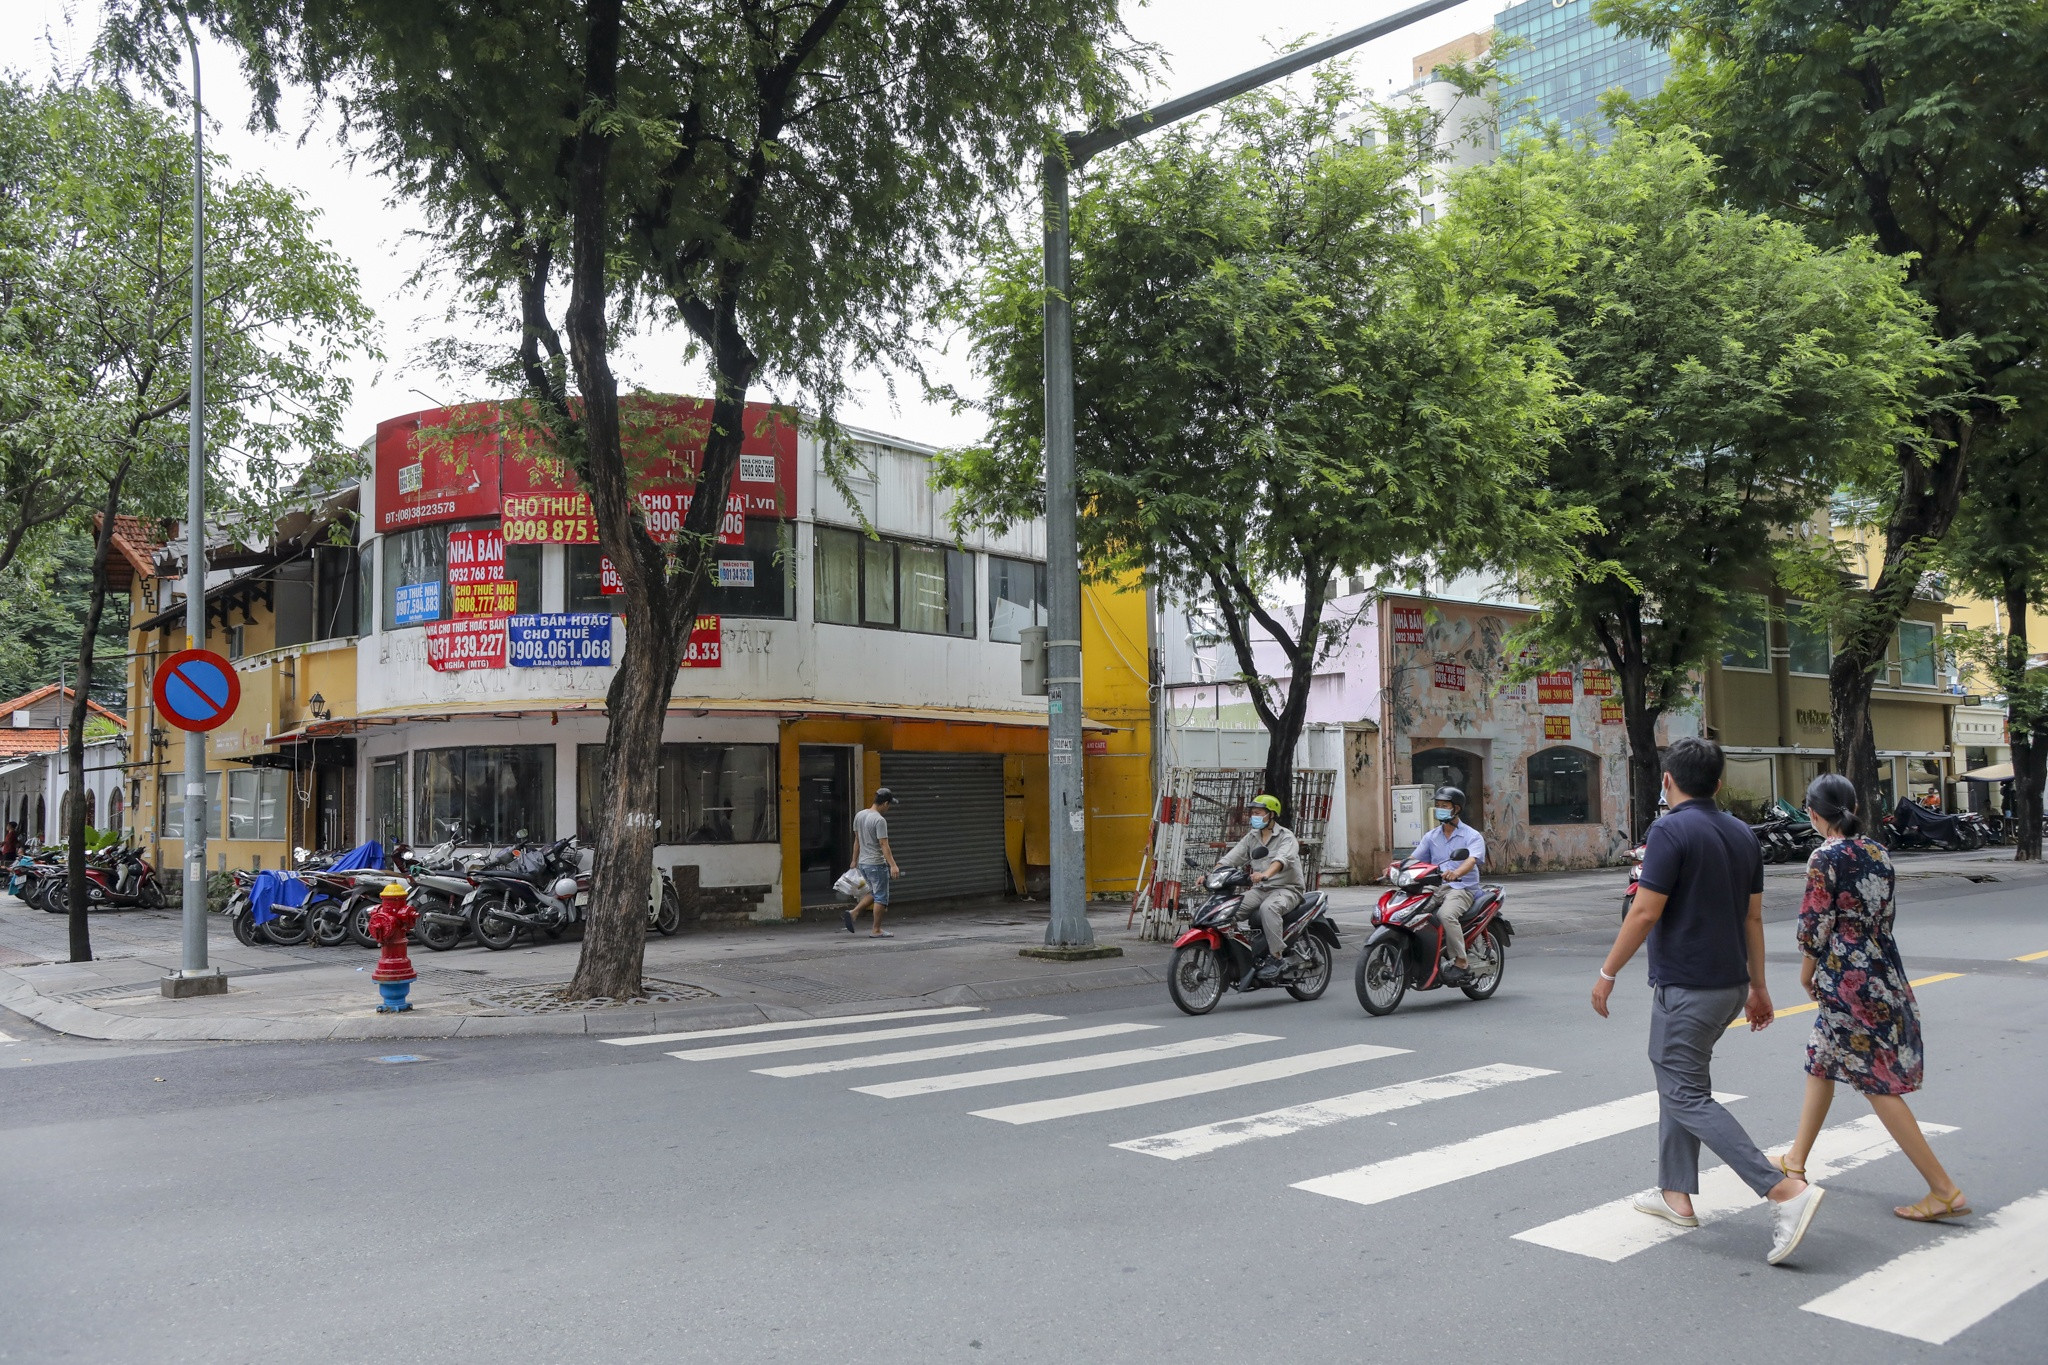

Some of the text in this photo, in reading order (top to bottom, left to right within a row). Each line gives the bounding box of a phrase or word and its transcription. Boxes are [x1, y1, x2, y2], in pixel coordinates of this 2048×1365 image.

[742, 464, 754, 477] 0902
[754, 465, 764, 477] 962
[504, 493, 586, 517] CHO THUÊ
[643, 494, 671, 510] CHO
[726, 494, 744, 512] HÀ
[385, 501, 455, 524] ĐT:(08)38223578
[503, 520, 548, 542] 0908
[552, 520, 588, 541] 875
[450, 531, 503, 564] NHÀ BÁN
[450, 566, 504, 582] 0932 768 782
[396, 584, 438, 600] CHO THUÊ NHÀ
[455, 582, 515, 596] CHO THUÊ NHÀ
[455, 596, 515, 612] 0908.777.488
[439, 622, 450, 634] CHO
[490, 618, 504, 630] BÁN
[511, 614, 608, 628] NHÀ BÁN HOẶC
[693, 617, 717, 630] HUÊ
[1394, 610, 1422, 629] NHÀ BÁN
[523, 627, 590, 640] CHO THUÊ
[428, 634, 504, 660] 0931.339.227
[510, 639, 610, 659] 0908.061.068
[467, 660, 489, 670] (MTG)
